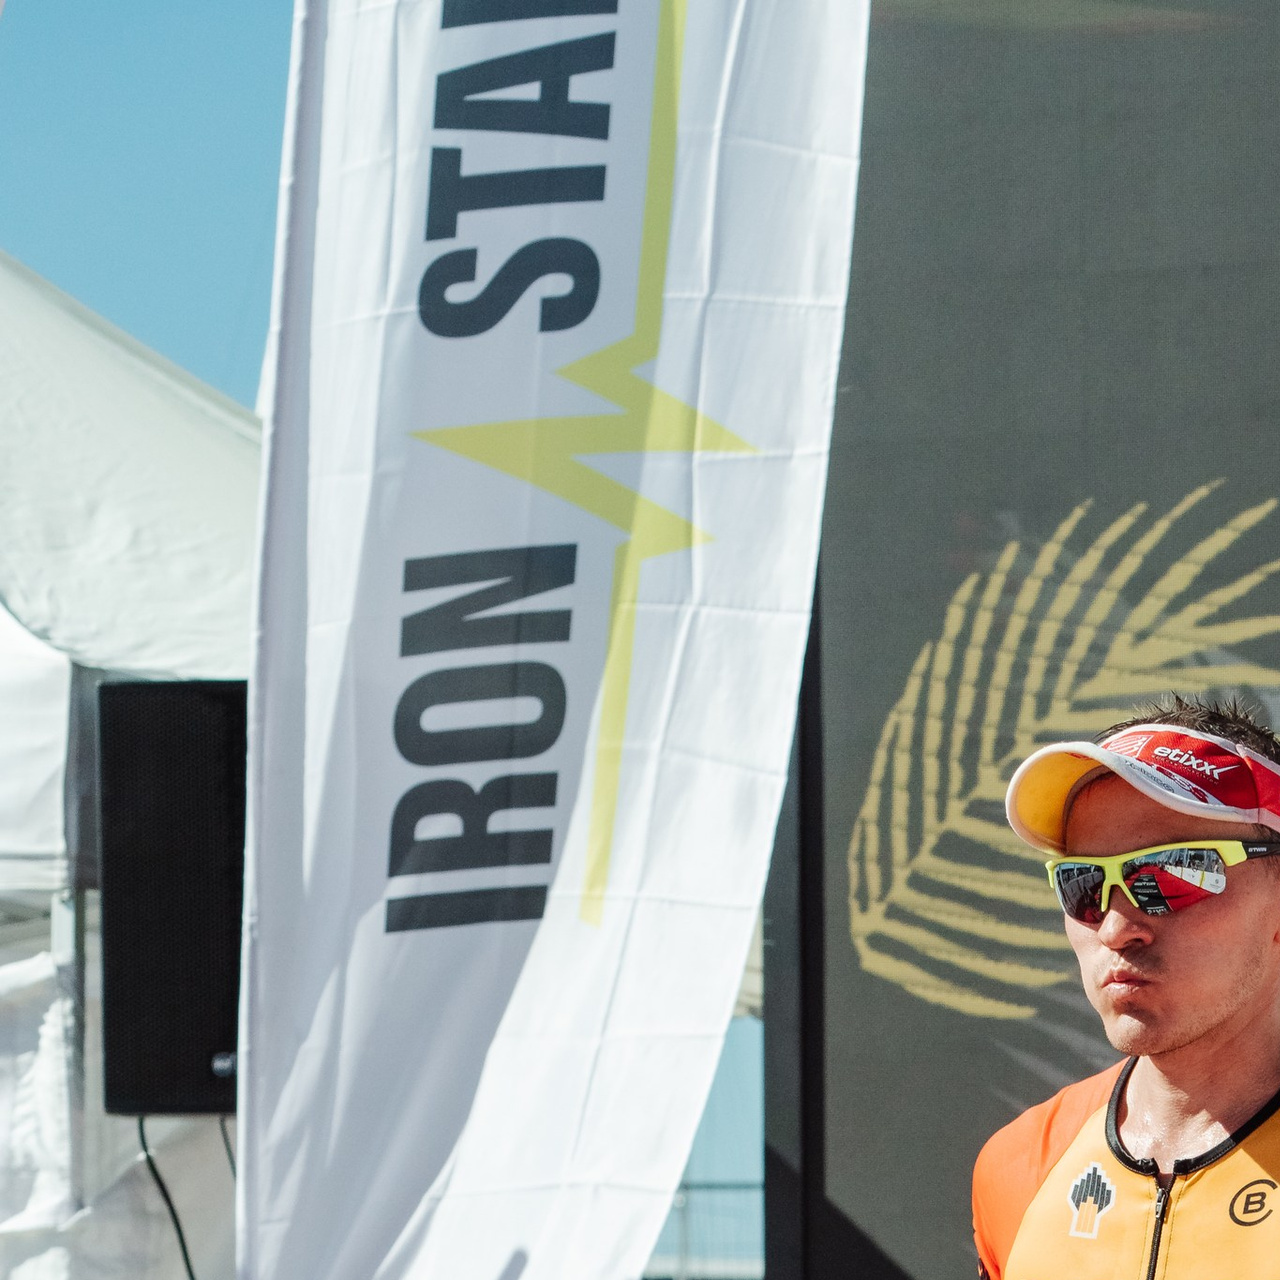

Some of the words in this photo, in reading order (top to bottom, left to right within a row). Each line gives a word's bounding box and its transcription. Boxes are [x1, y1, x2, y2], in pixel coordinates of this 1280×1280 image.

[418, 0, 619, 339] STA
[385, 543, 577, 933] IRON
[1153, 746, 1217, 775] etixx
